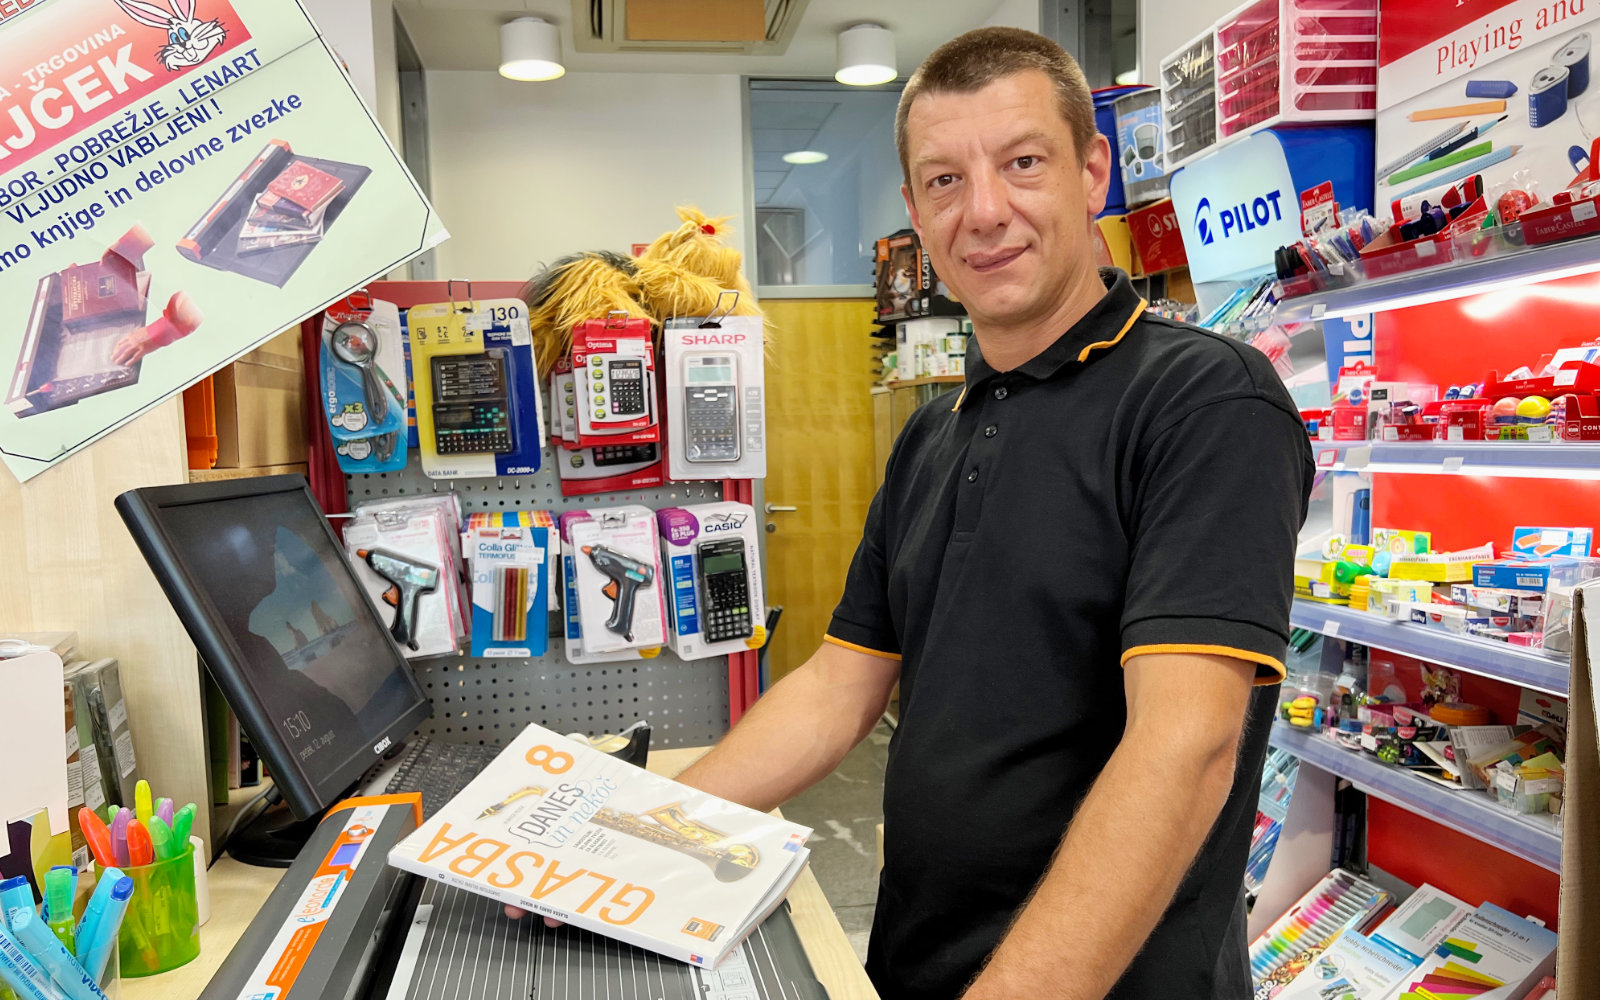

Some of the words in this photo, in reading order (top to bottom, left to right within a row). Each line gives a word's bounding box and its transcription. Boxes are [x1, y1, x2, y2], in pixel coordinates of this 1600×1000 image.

[22, 24, 126, 83] TRGOVINA
[1435, 18, 1523, 76] Playing
[1535, 0, 1585, 31] and
[0, 42, 155, 160] JČEK
[54, 100, 169, 173] POBREŽJE
[178, 48, 262, 105] LENART
[5, 161, 109, 224] VLJUDNO
[107, 104, 212, 168] VABLJENI
[30, 202, 106, 249] knjige
[104, 187, 133, 208] in
[135, 136, 224, 193] delovne
[225, 94, 302, 144] zvezke
[1219, 190, 1282, 239] PILOT
[489, 306, 519, 321] 130
[681, 334, 746, 345] SHARP
[478, 543, 503, 552] Colla
[704, 521, 742, 533] CASIO
[283, 710, 312, 739] 15:10
[373, 736, 392, 754] CIBOX
[525, 744, 575, 775] 8
[517, 783, 584, 836] DANES
[546, 825, 574, 843] in
[569, 776, 617, 825] nekoč
[417, 822, 656, 926] GLASBA
